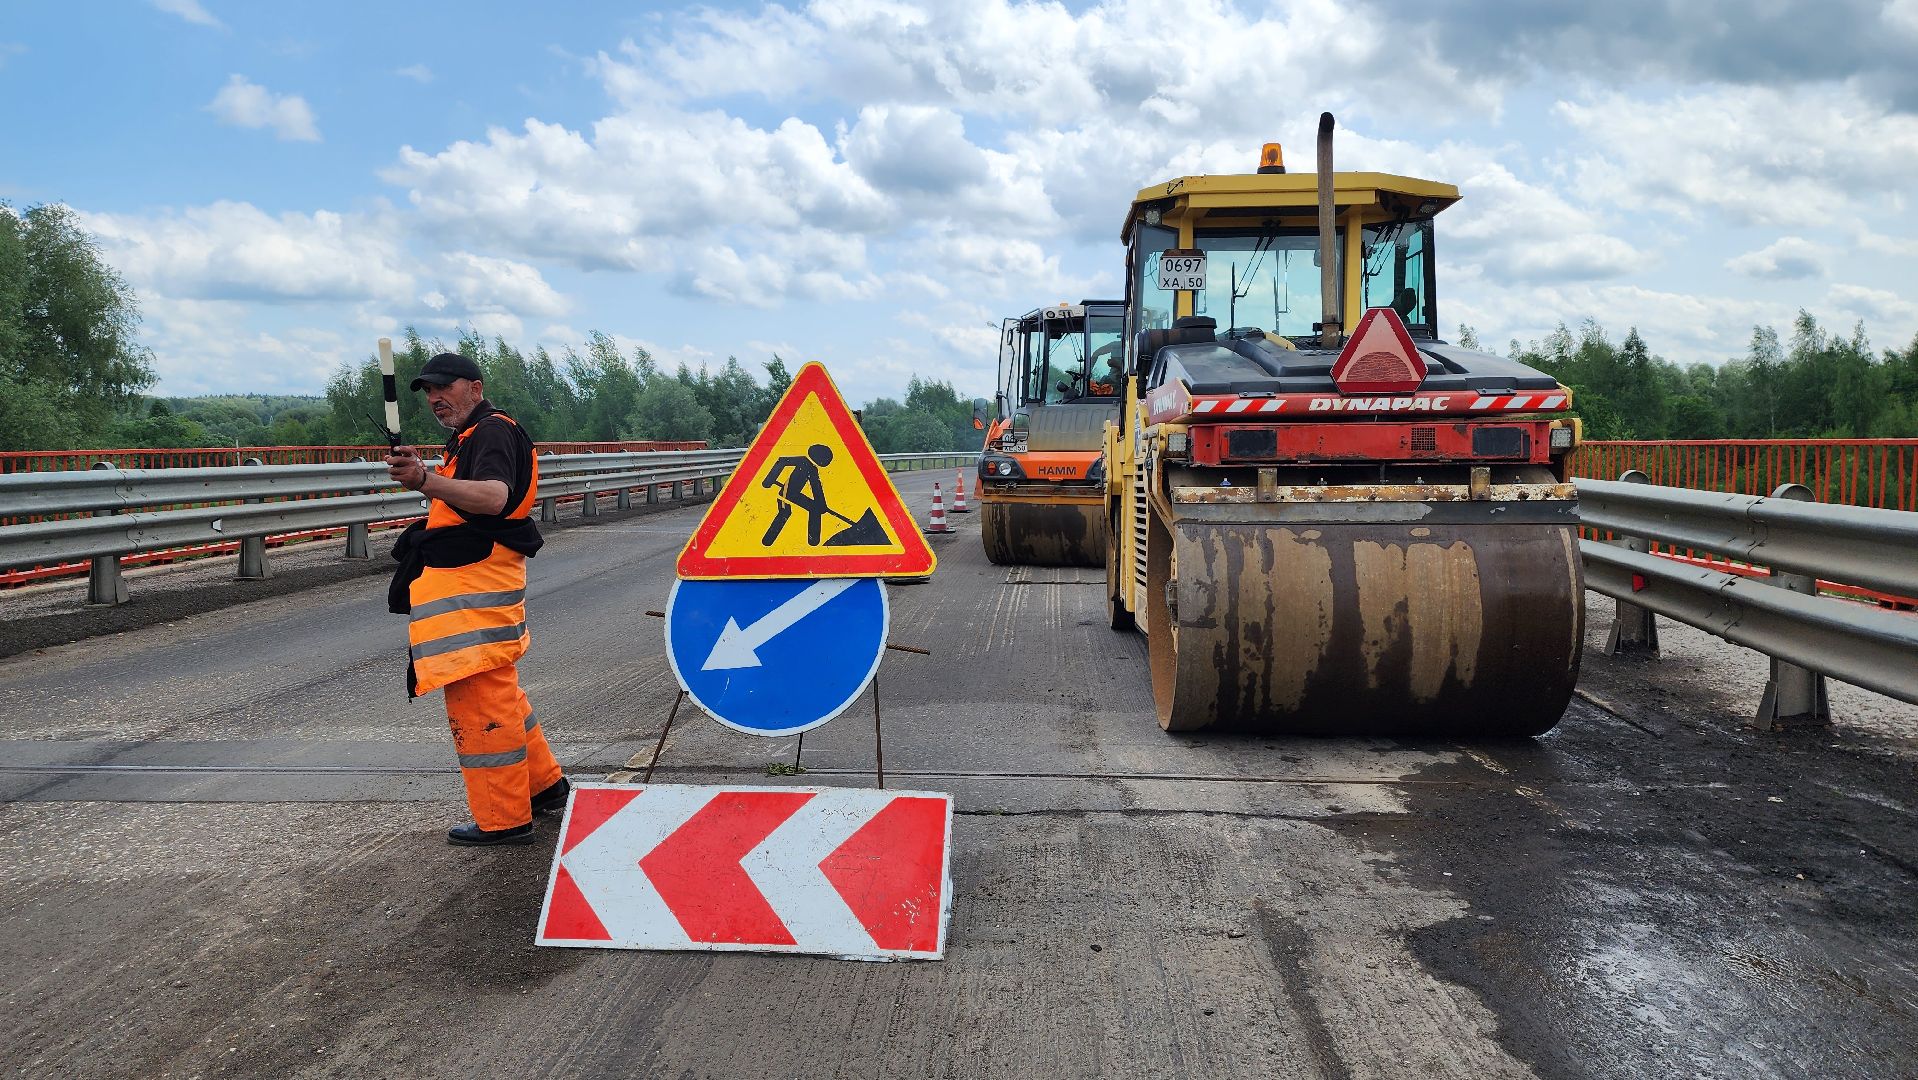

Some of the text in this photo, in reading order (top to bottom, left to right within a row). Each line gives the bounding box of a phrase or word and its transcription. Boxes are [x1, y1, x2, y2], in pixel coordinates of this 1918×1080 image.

[1165, 259, 1202, 272] 0697
[1188, 277, 1203, 288] 50
[1308, 396, 1451, 411] DYNAPAC
[1038, 465, 1077, 476] HAMM
